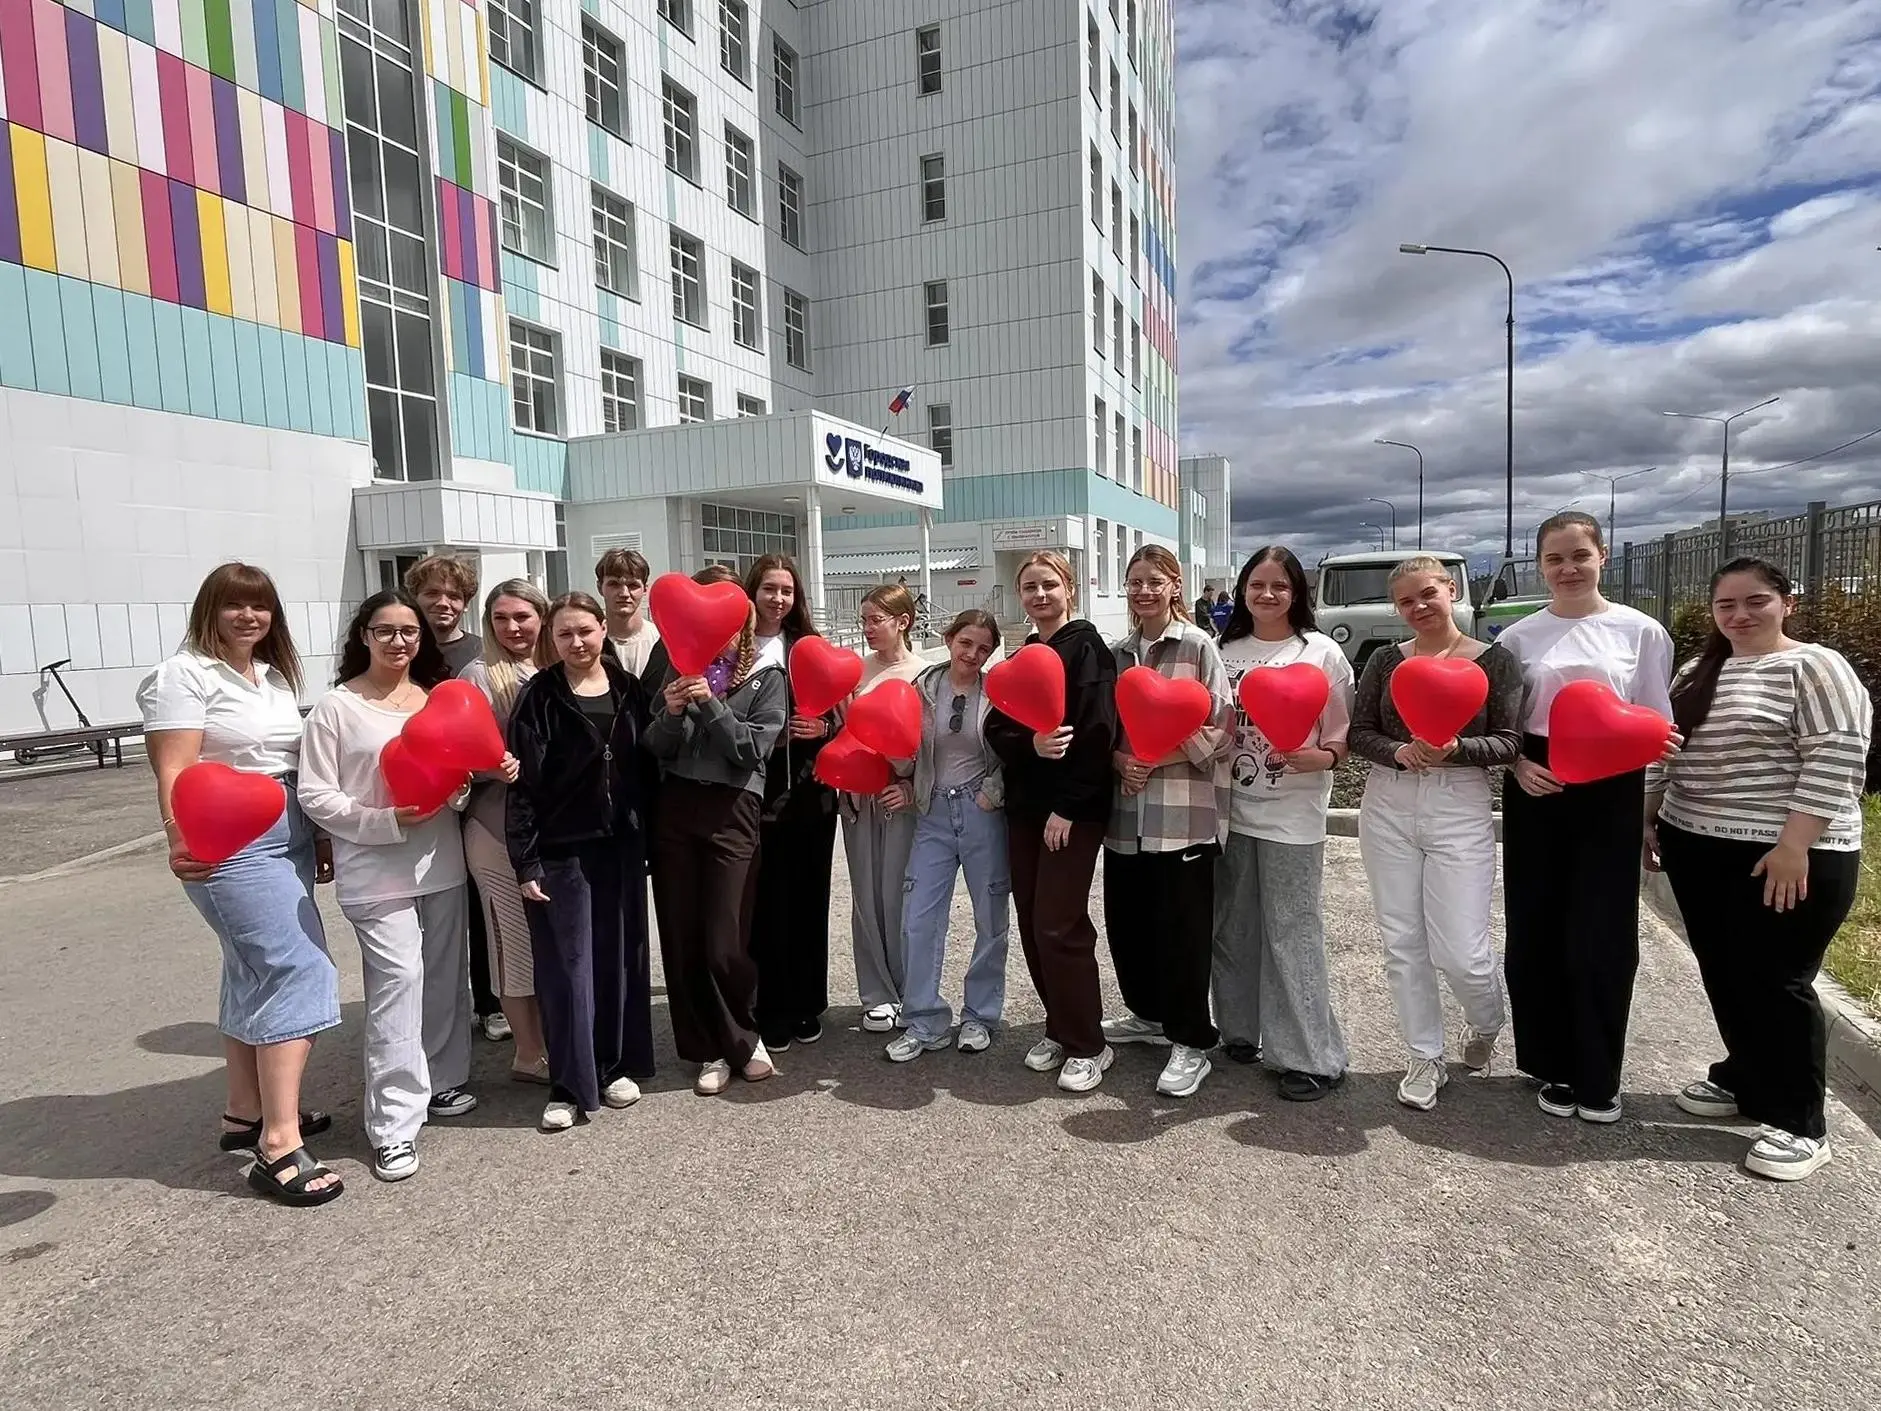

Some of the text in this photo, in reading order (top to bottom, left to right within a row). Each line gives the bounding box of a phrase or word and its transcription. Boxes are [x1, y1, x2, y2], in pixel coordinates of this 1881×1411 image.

[1715, 825, 1777, 838] DO NOT PASS
